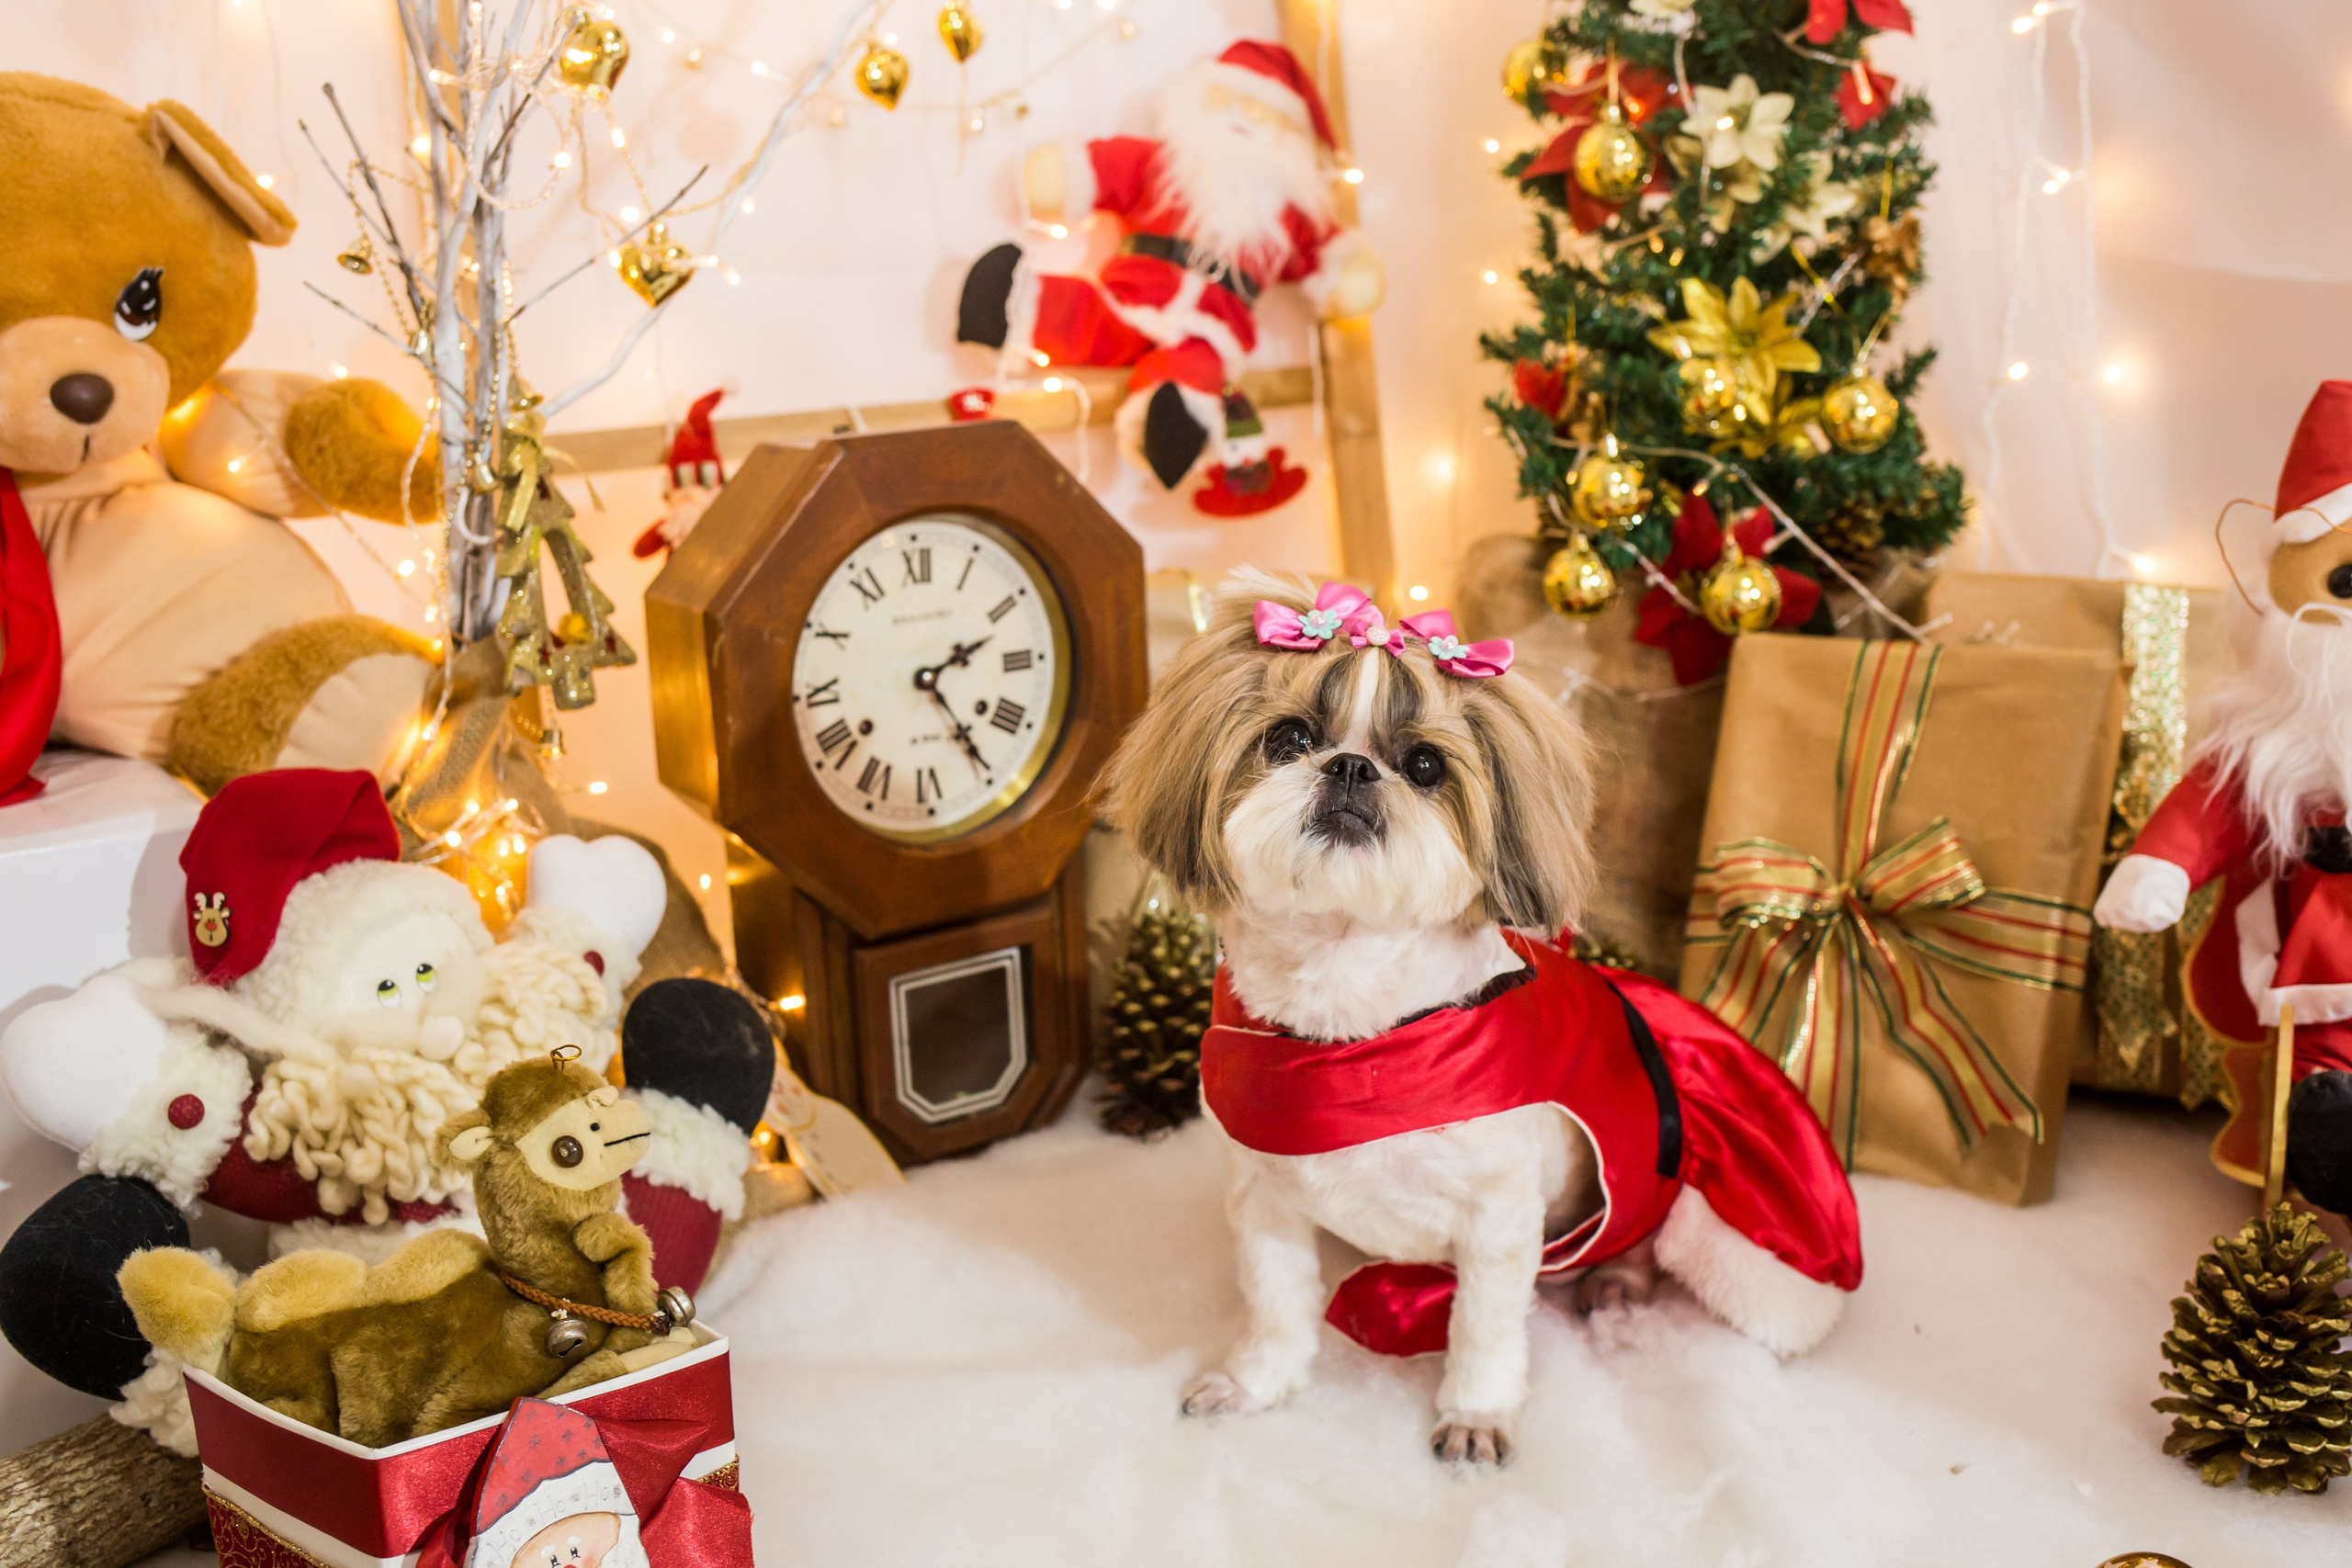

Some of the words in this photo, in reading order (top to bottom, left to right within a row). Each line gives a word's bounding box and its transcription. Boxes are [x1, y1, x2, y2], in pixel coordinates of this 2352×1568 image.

[901, 547, 933, 589] XII
[956, 557, 974, 592] I
[849, 566, 886, 612] XI
[987, 593, 1018, 625] II
[814, 621, 851, 651] X
[1002, 649, 1034, 674] III
[805, 677, 842, 709] IX
[815, 717, 859, 772] VIII
[855, 755, 892, 801] VII
[916, 766, 943, 805] VI
